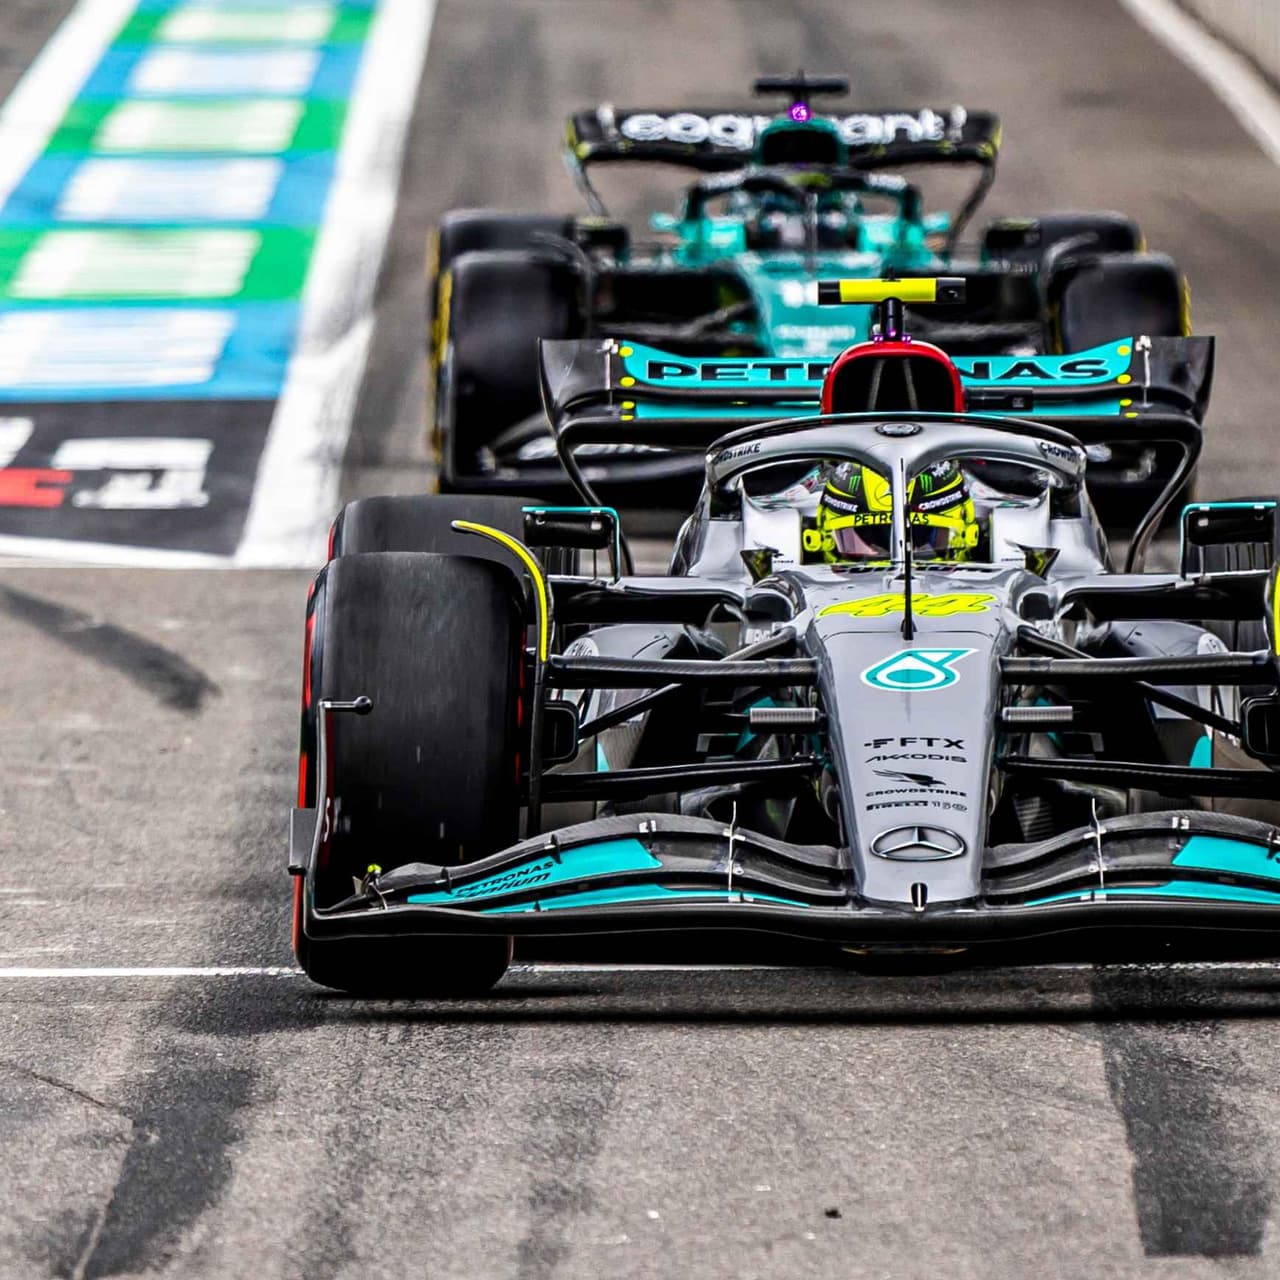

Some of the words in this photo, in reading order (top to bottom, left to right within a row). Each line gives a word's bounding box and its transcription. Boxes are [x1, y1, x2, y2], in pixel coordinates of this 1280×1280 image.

[818, 593, 997, 617] 44
[900, 737, 965, 750] FTX
[865, 788, 967, 798] CROWDSTRIKE
[456, 861, 554, 894] PETRONAS
